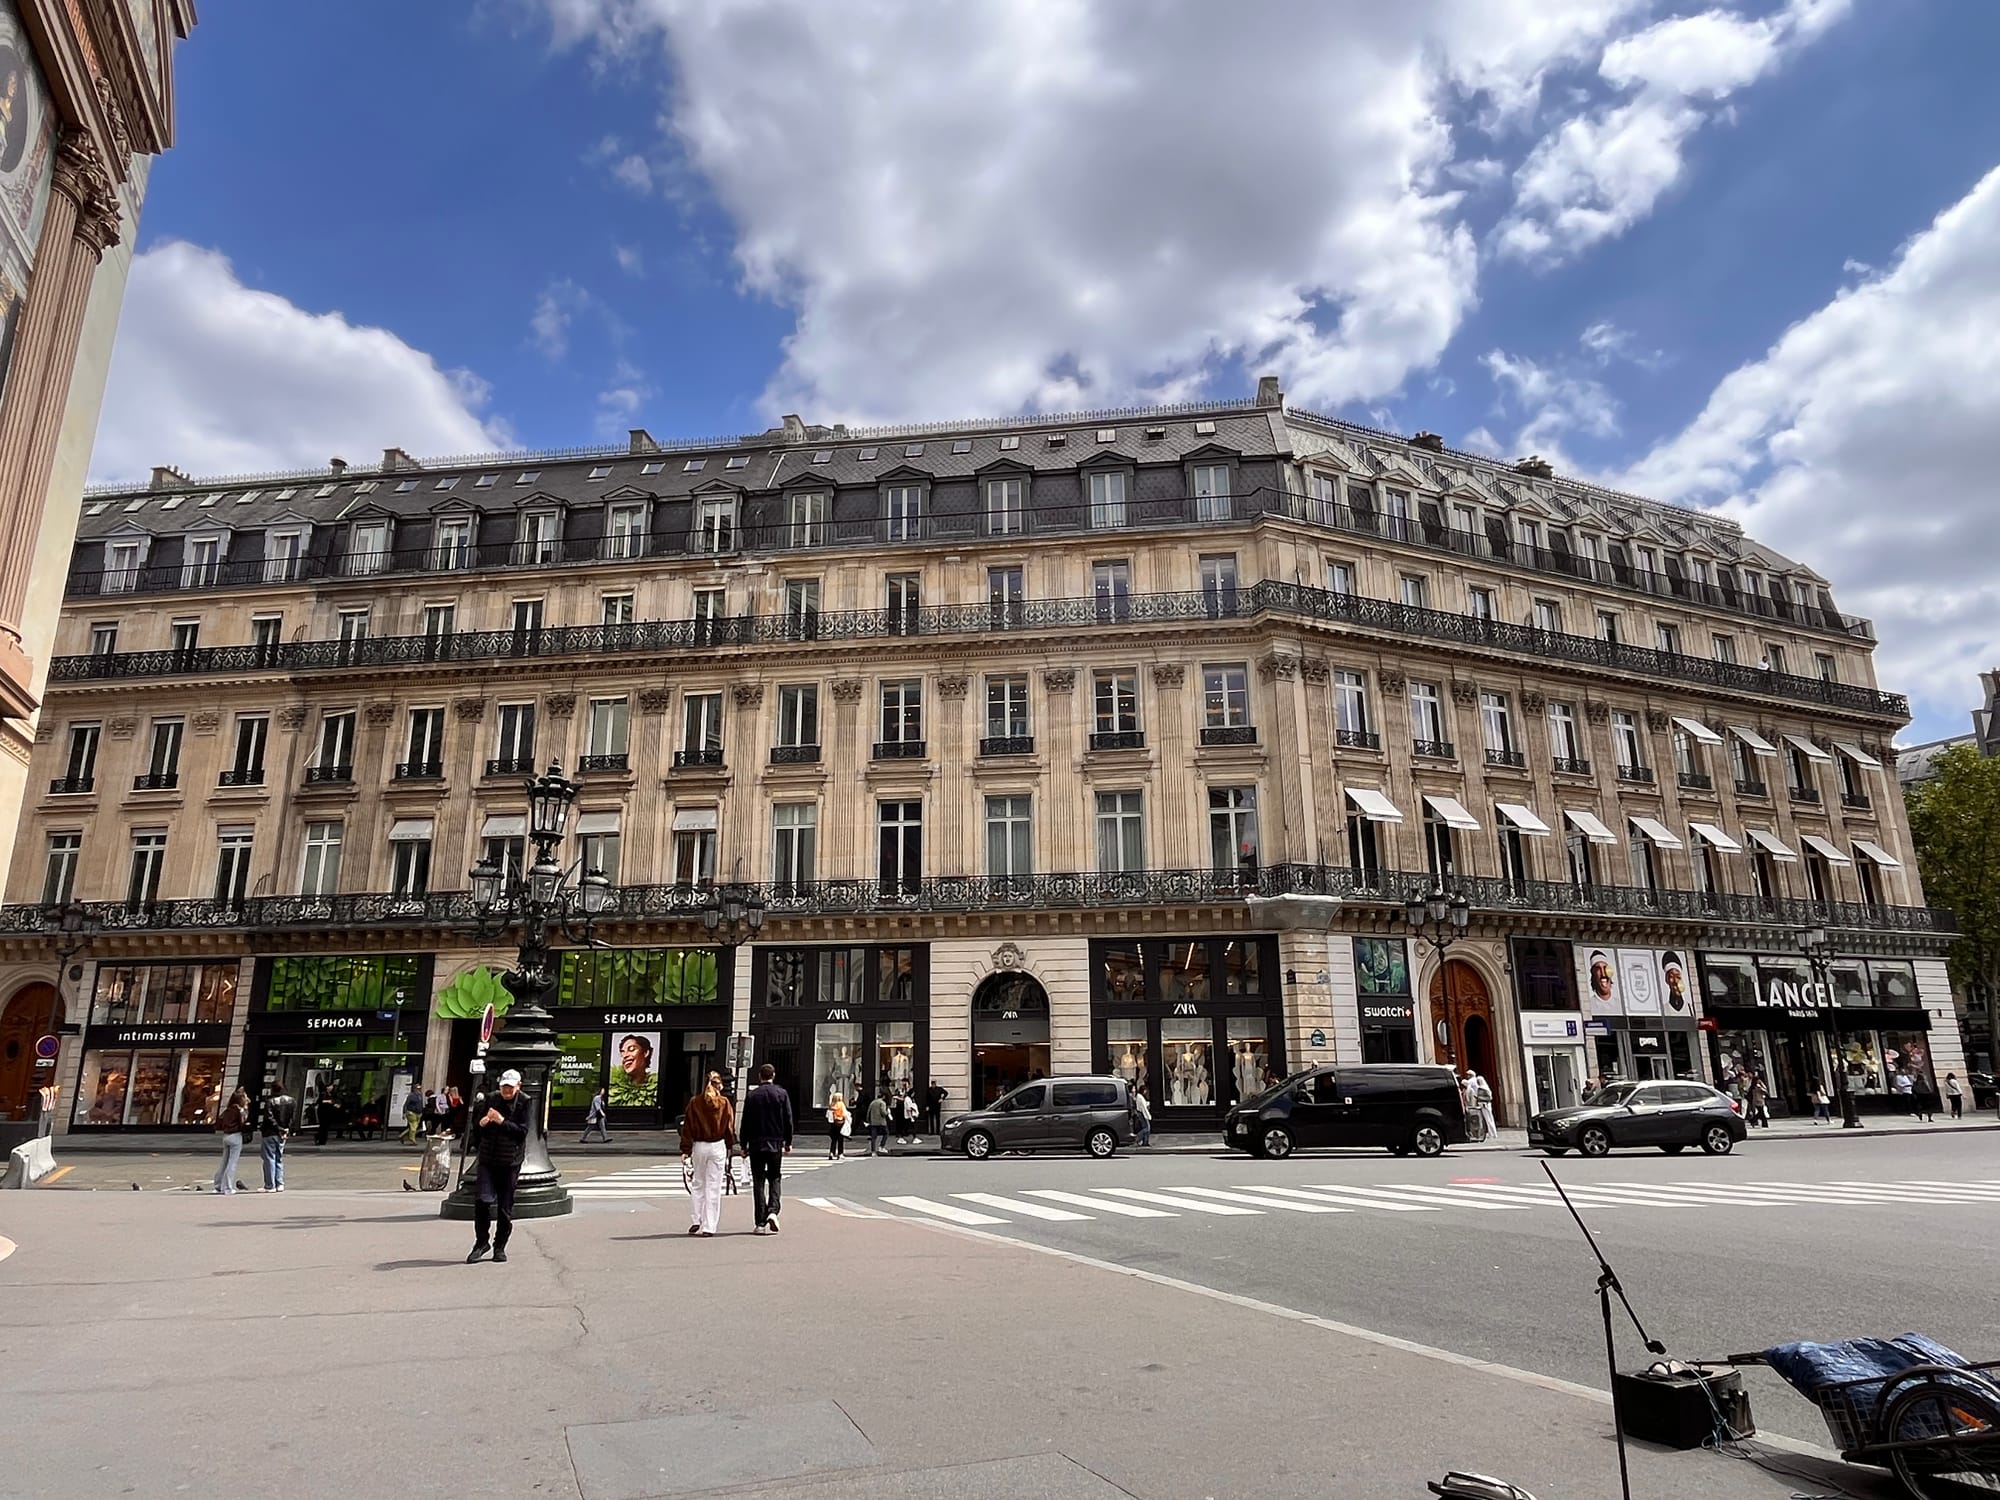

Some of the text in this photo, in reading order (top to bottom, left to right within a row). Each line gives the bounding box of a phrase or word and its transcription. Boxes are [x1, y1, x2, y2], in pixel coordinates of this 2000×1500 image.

[1753, 982, 1842, 1007] LANCEL
[1173, 1003, 1198, 1015] ZARA
[1363, 1006, 1405, 1017] swatch
[307, 1018, 363, 1029] SEPHORA
[603, 1013, 664, 1024] SEPHORA
[118, 1031, 197, 1041] intimissimi
[561, 1055, 577, 1063] NOS
